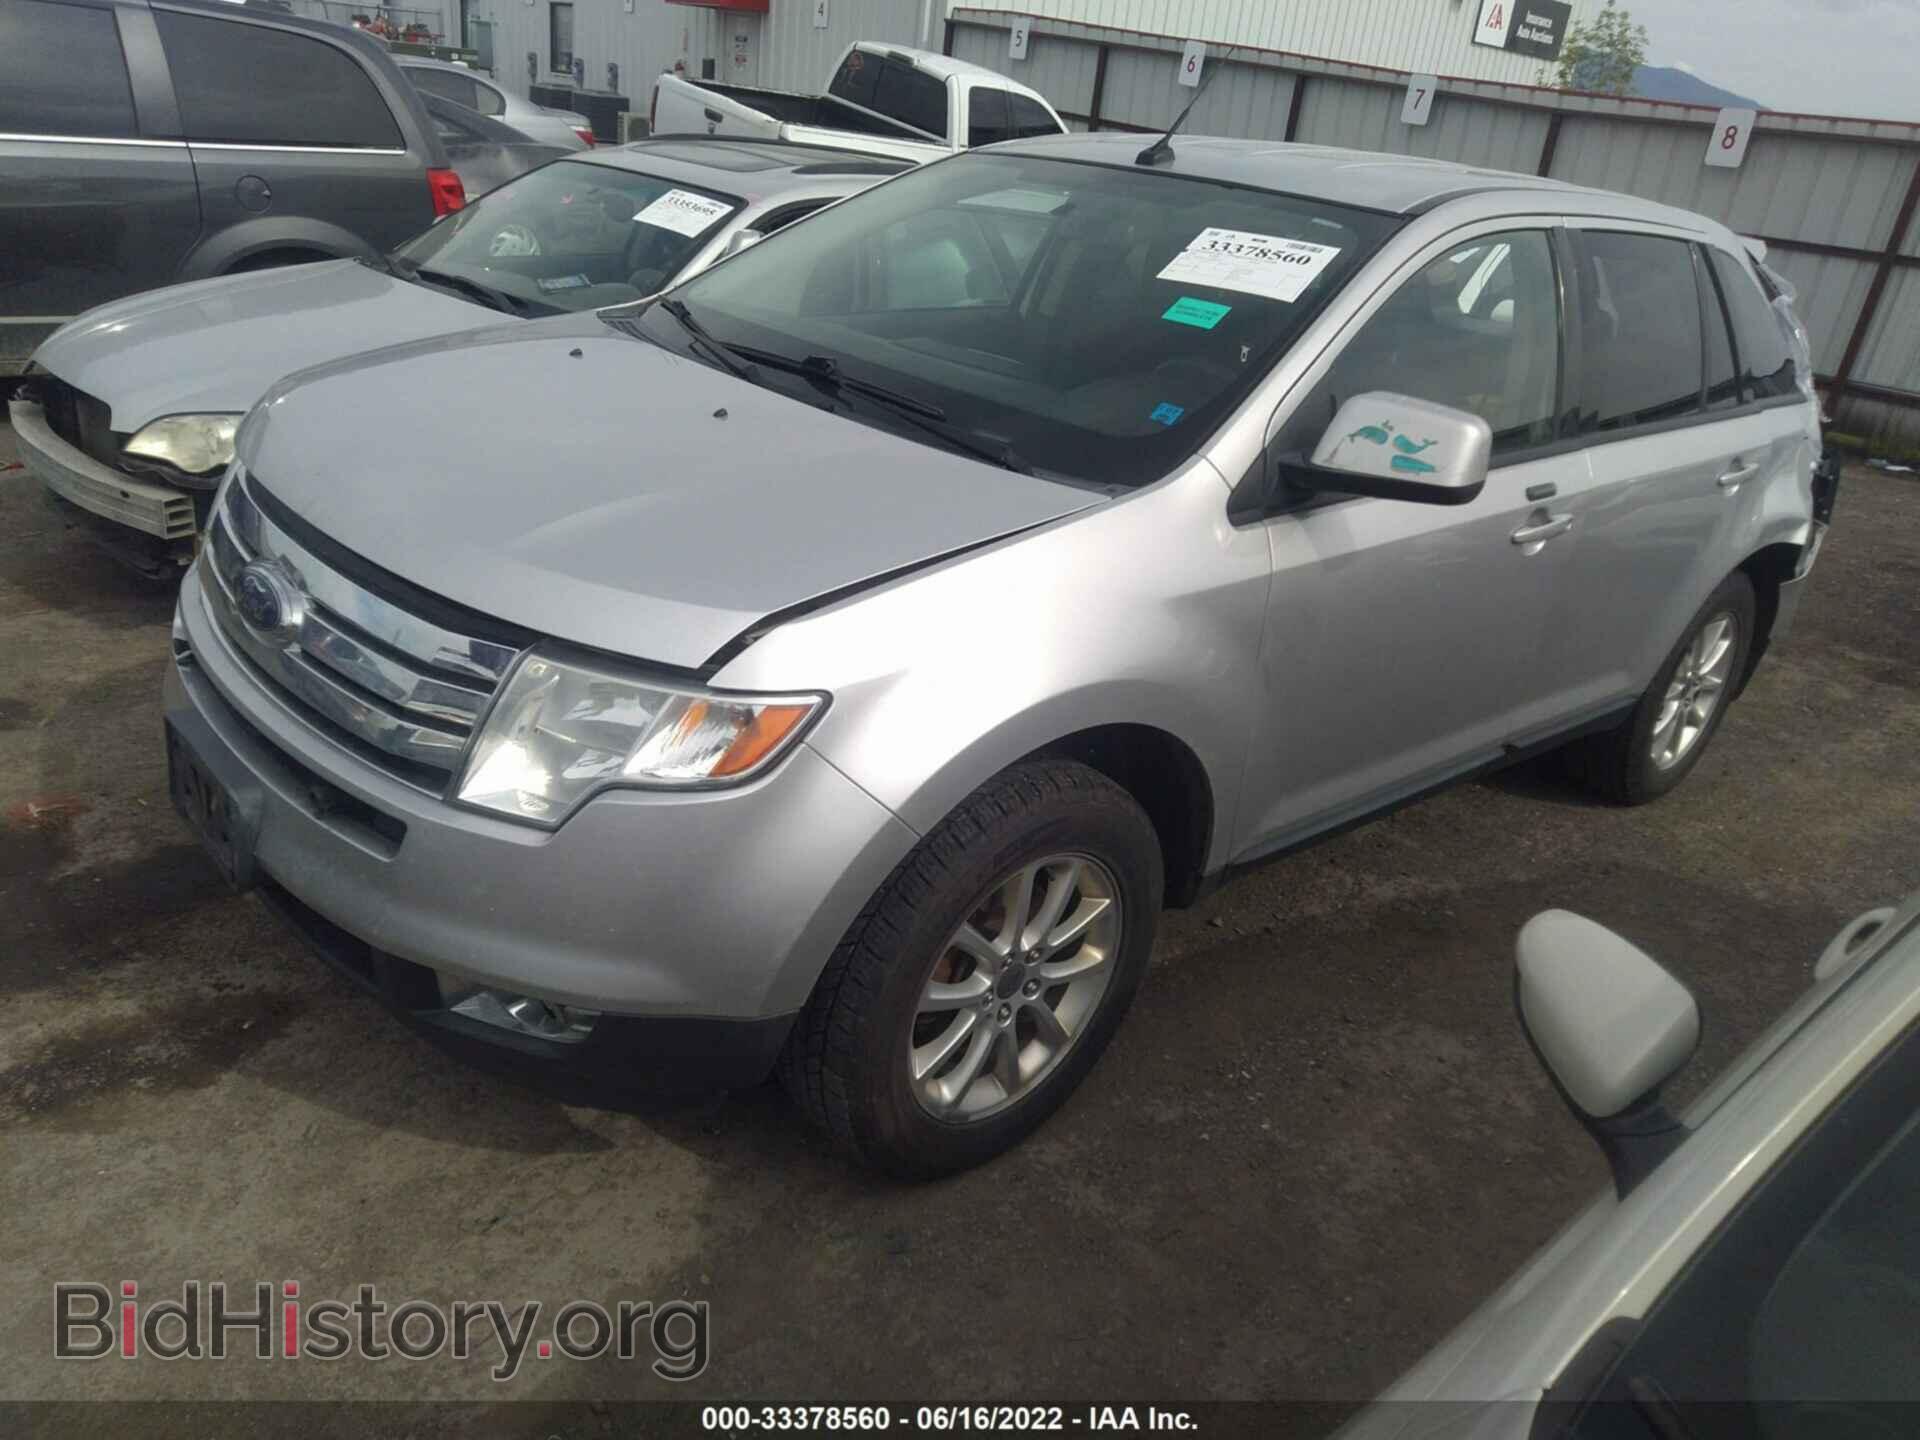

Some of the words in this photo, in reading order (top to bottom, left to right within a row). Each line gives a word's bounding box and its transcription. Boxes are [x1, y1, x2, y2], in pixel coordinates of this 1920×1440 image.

[817, 1, 824, 16] 4
[1015, 29, 1023, 47] 5
[1187, 54, 1196, 73] 6
[1414, 88, 1426, 110] 7
[1721, 125, 1738, 150] 8
[1202, 239, 1312, 266] 33378560
